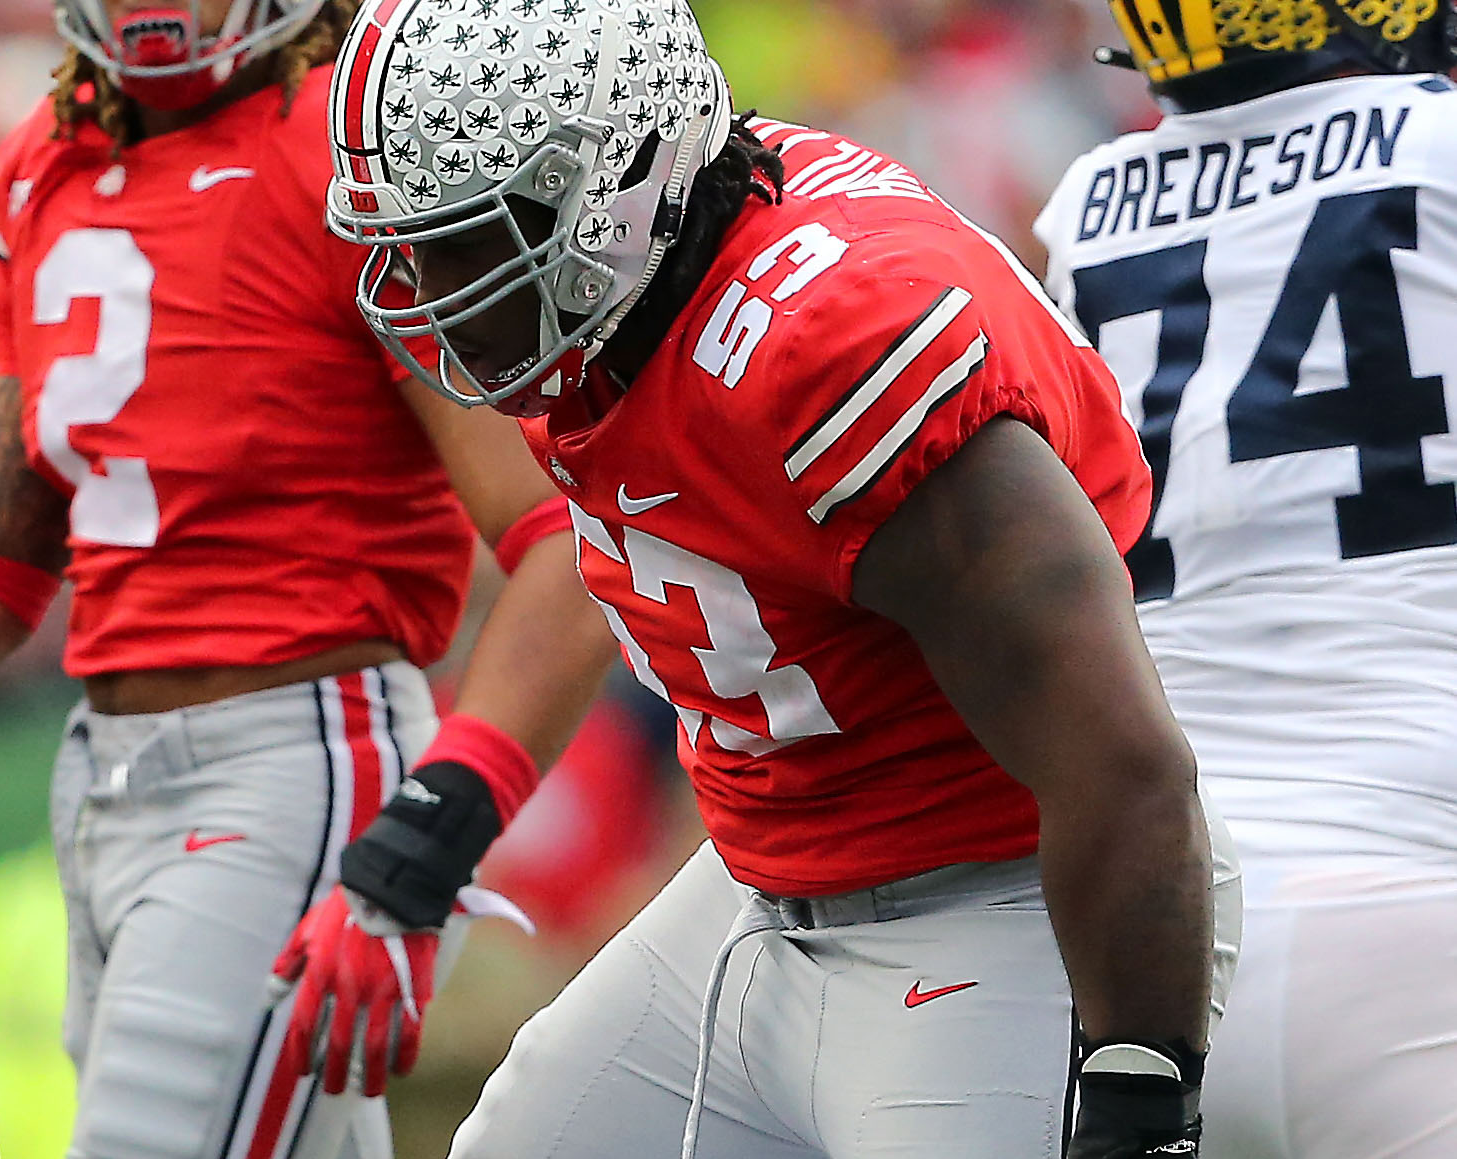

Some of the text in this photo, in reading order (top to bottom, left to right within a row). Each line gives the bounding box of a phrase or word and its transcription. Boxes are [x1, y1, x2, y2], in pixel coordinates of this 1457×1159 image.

[1078, 106, 1410, 243] BREDESON
[34, 228, 160, 548] 2
[693, 222, 850, 389] 53
[1072, 186, 1457, 604] 74
[568, 497, 843, 758] 53
